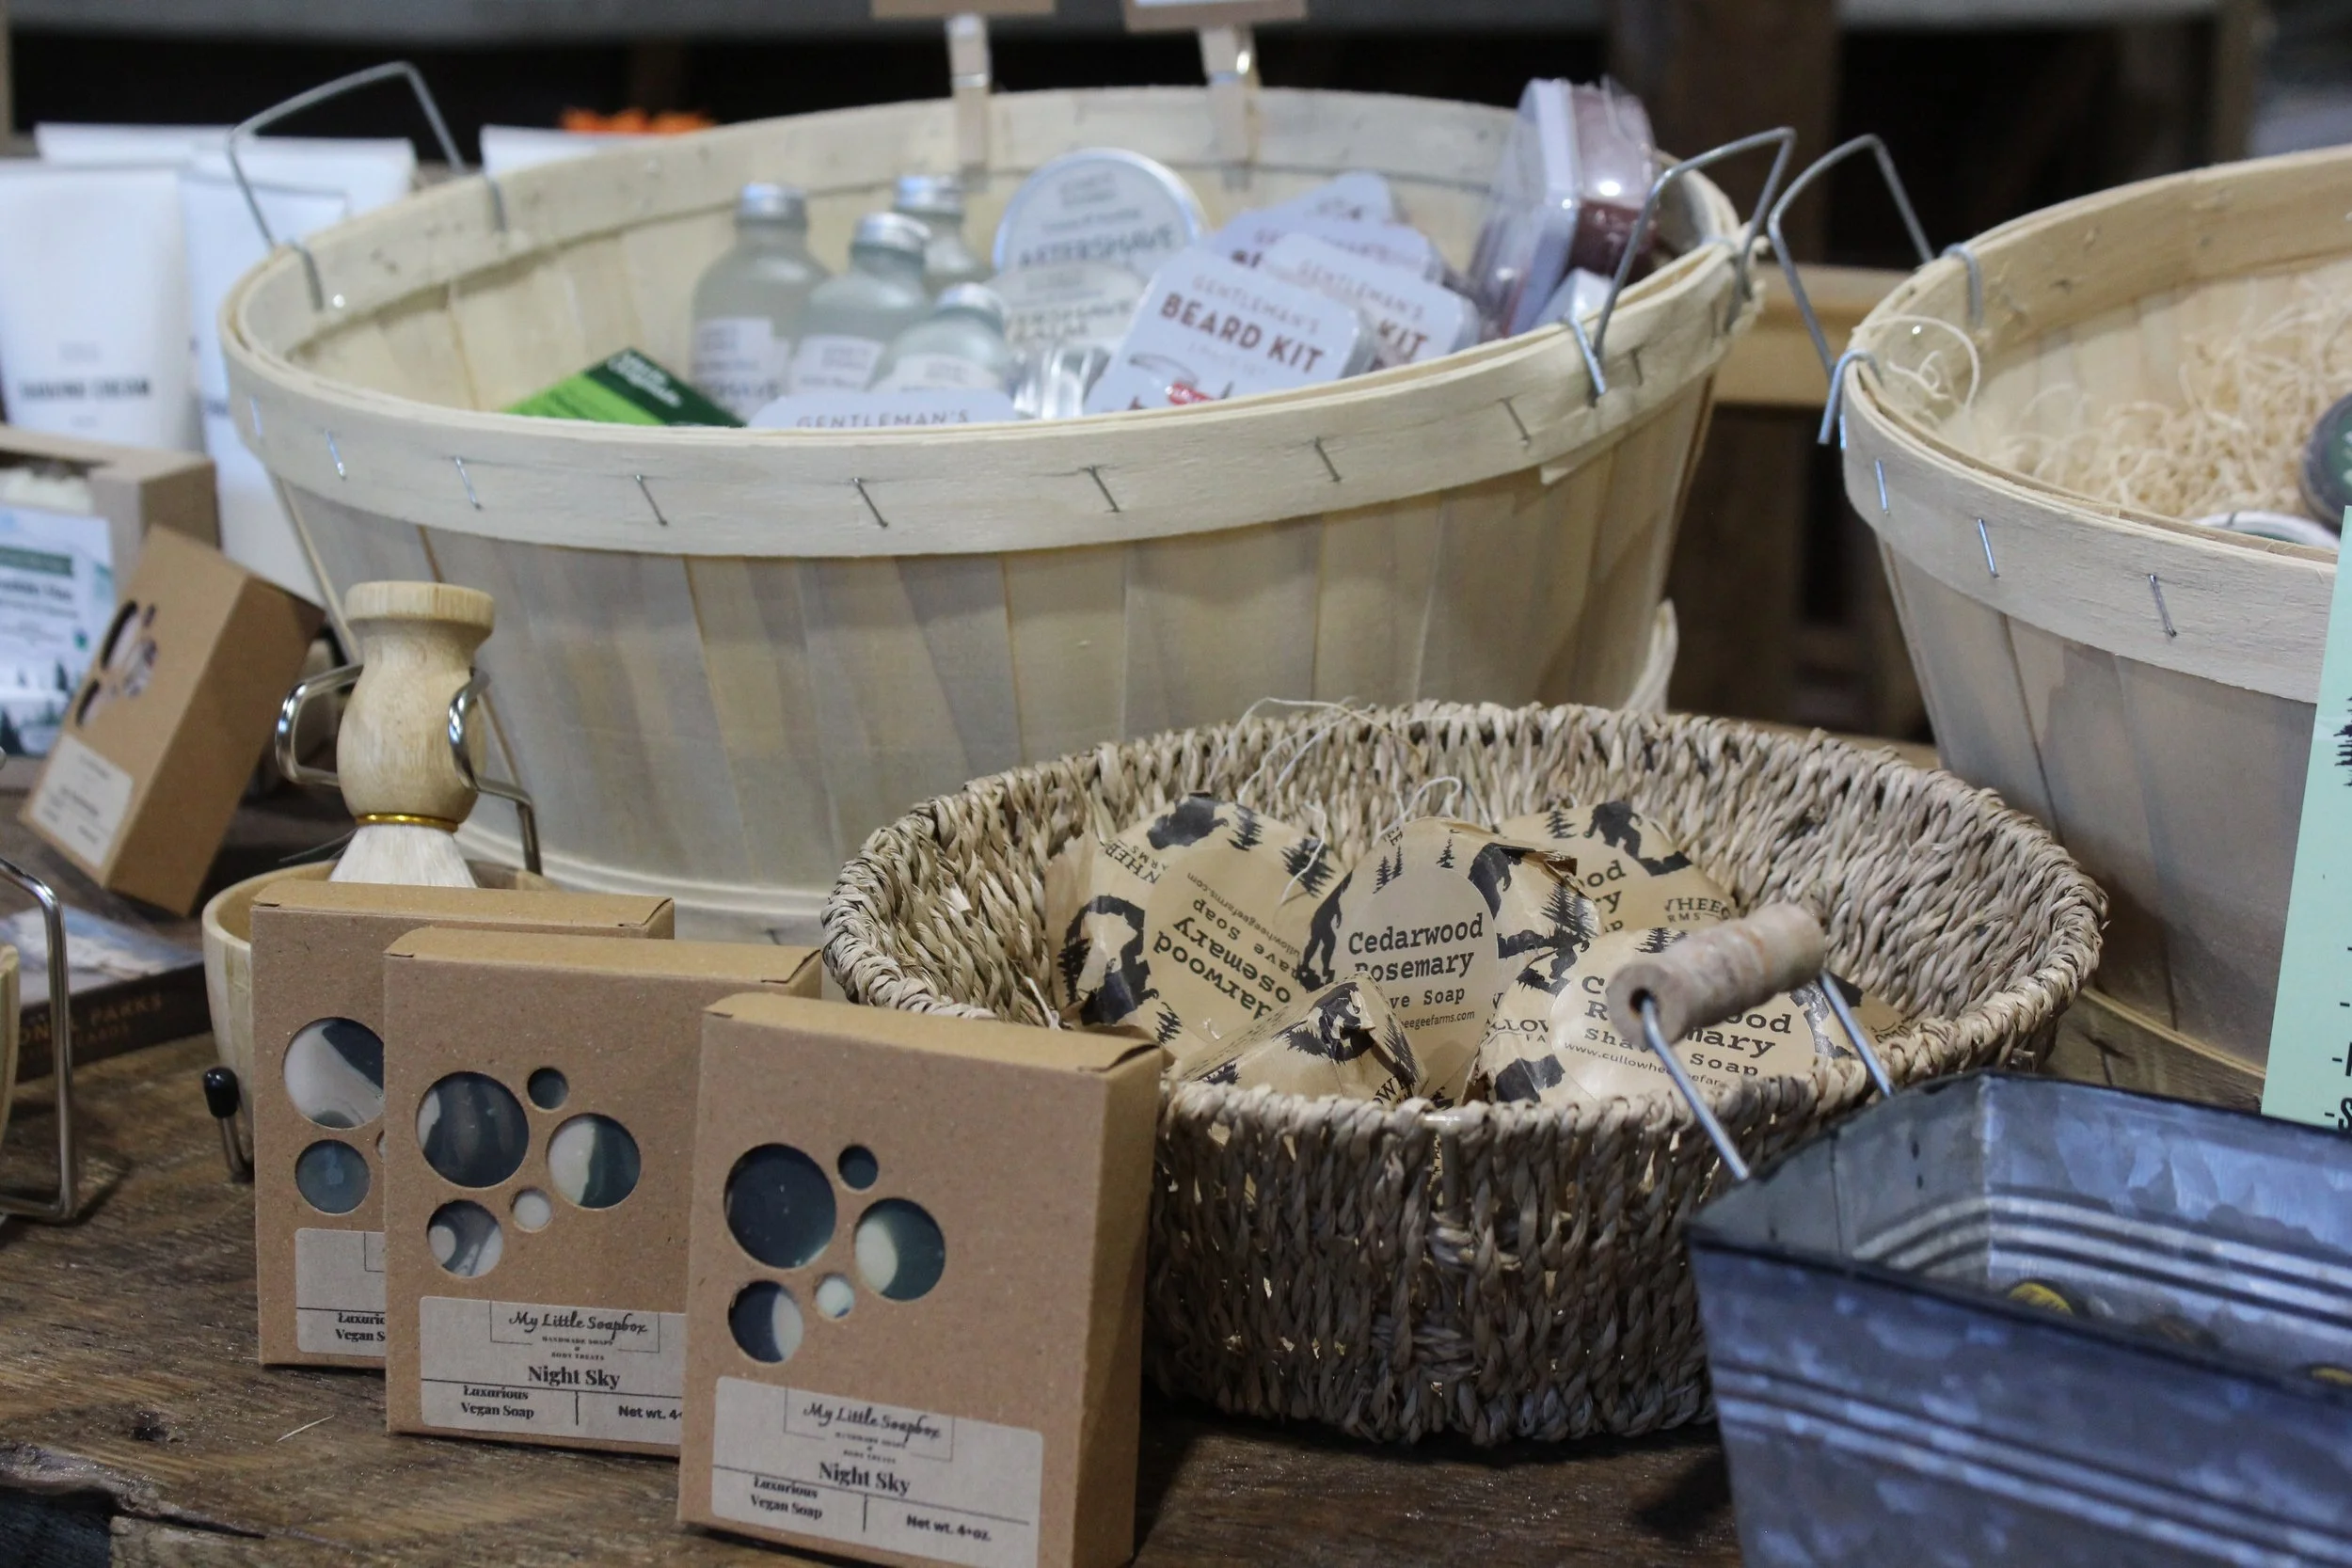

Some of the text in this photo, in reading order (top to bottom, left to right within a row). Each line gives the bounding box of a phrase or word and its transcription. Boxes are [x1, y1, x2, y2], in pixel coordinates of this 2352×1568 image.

[1160, 292, 1263, 351] BEARD
[1266, 333, 1325, 373] KIT
[1376, 318, 1429, 361] KIT
[795, 408, 969, 429] GENTLEMAN'S
[1348, 911, 1484, 956] Cedarwood
[1423, 987, 1465, 1006] Soap
[335, 1328, 374, 1342] Vegan
[509, 1310, 648, 1340] My Little Soapbox
[542, 1336, 586, 1345] HANDMADE
[528, 1365, 621, 1390] Night Sky
[461, 1402, 534, 1419] Vegan Soap
[617, 1405, 644, 1418] Net
[645, 1407, 666, 1419] wt.
[803, 1402, 941, 1444] My Little Soapbox
[754, 1475, 818, 1499] Luxurious
[818, 1461, 910, 1497] Night Sky
[750, 1495, 823, 1520] Vegan Soap
[906, 1513, 930, 1528] Net
[932, 1521, 954, 1535] wt.
